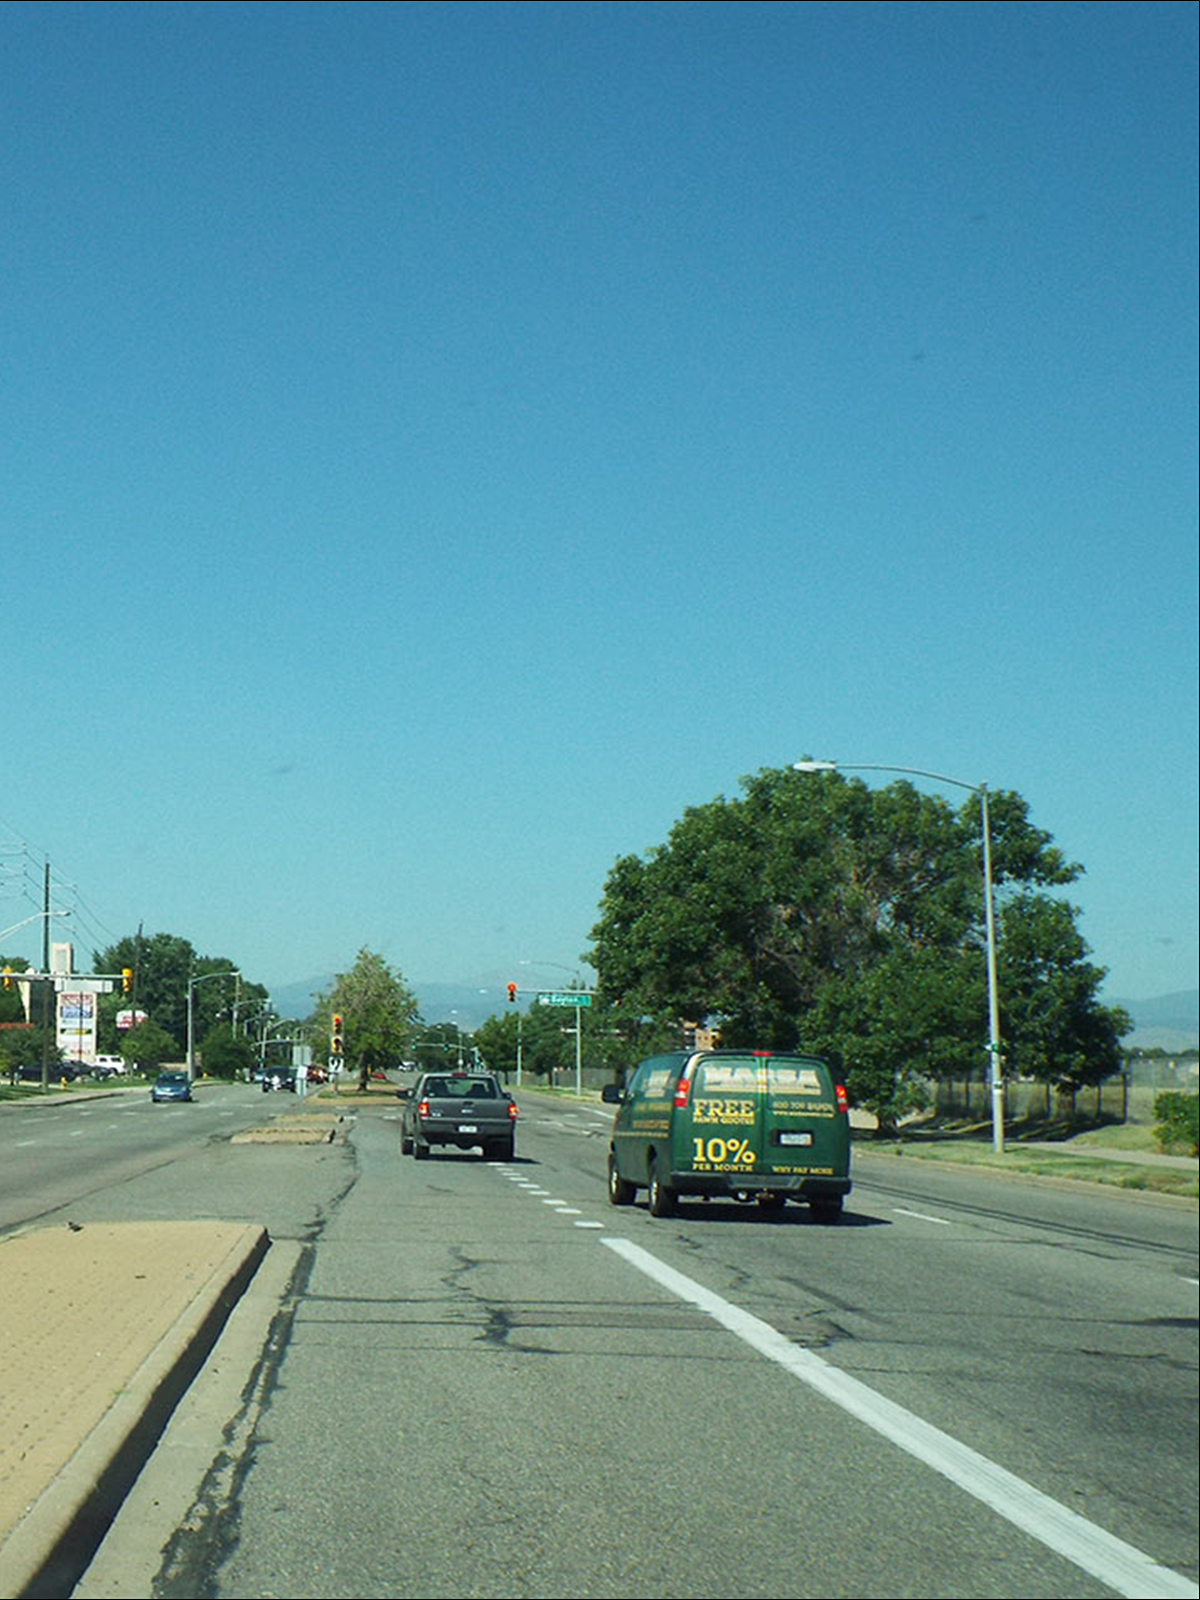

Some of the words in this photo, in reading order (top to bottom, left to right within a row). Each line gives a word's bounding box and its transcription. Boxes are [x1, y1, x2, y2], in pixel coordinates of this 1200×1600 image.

[693, 1098, 755, 1117] FREE
[693, 1137, 757, 1163] 10%
[714, 1163, 753, 1172] MONTH
[771, 1165, 792, 1173] WHY
